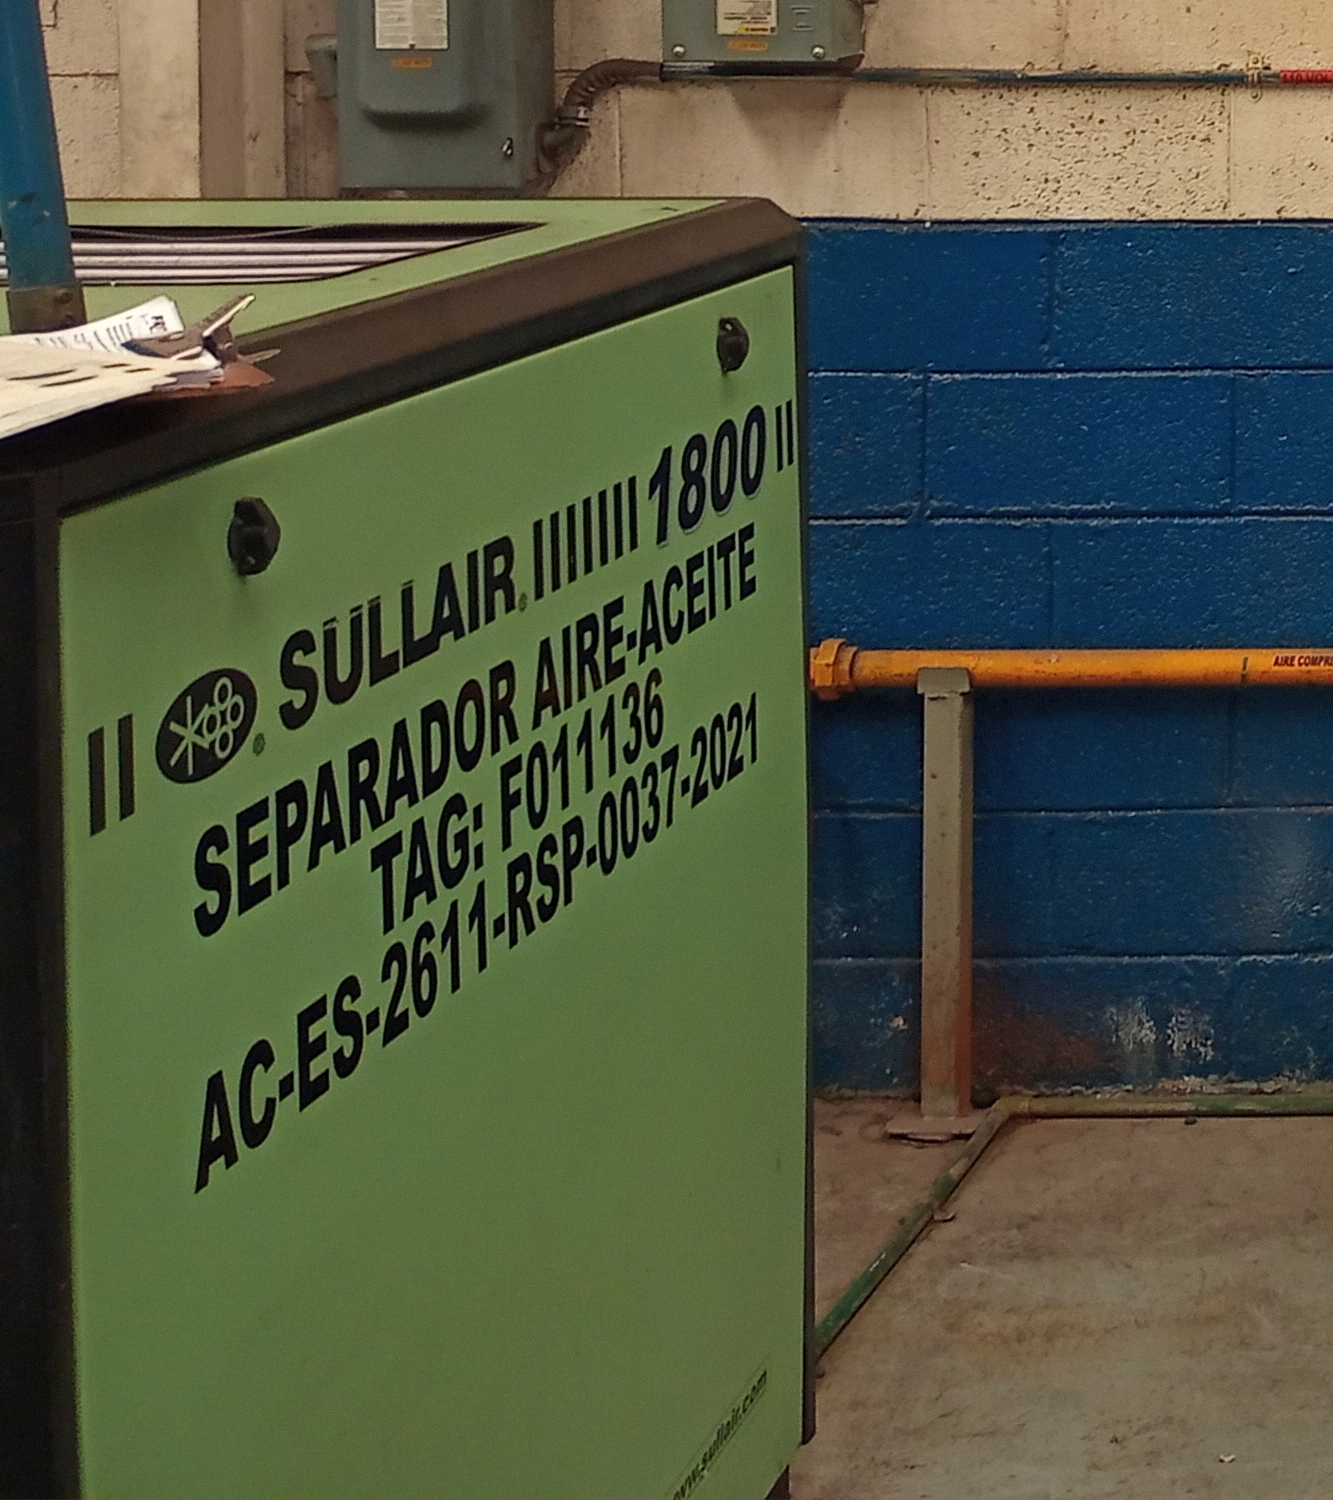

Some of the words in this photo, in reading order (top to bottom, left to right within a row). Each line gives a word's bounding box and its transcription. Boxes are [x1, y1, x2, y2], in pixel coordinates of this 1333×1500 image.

[279, 534, 517, 730] SULLAIR
[647, 404, 767, 547] 1800
[1273, 655, 1296, 667] AIRE
[193, 660, 517, 937] SEPARADOR
[532, 524, 758, 730] AIRE-ACEITE
[371, 791, 484, 935] TAG:
[500, 667, 664, 851] F011136
[194, 691, 759, 1194] AC-ES-2611-RSP-0037-2021
